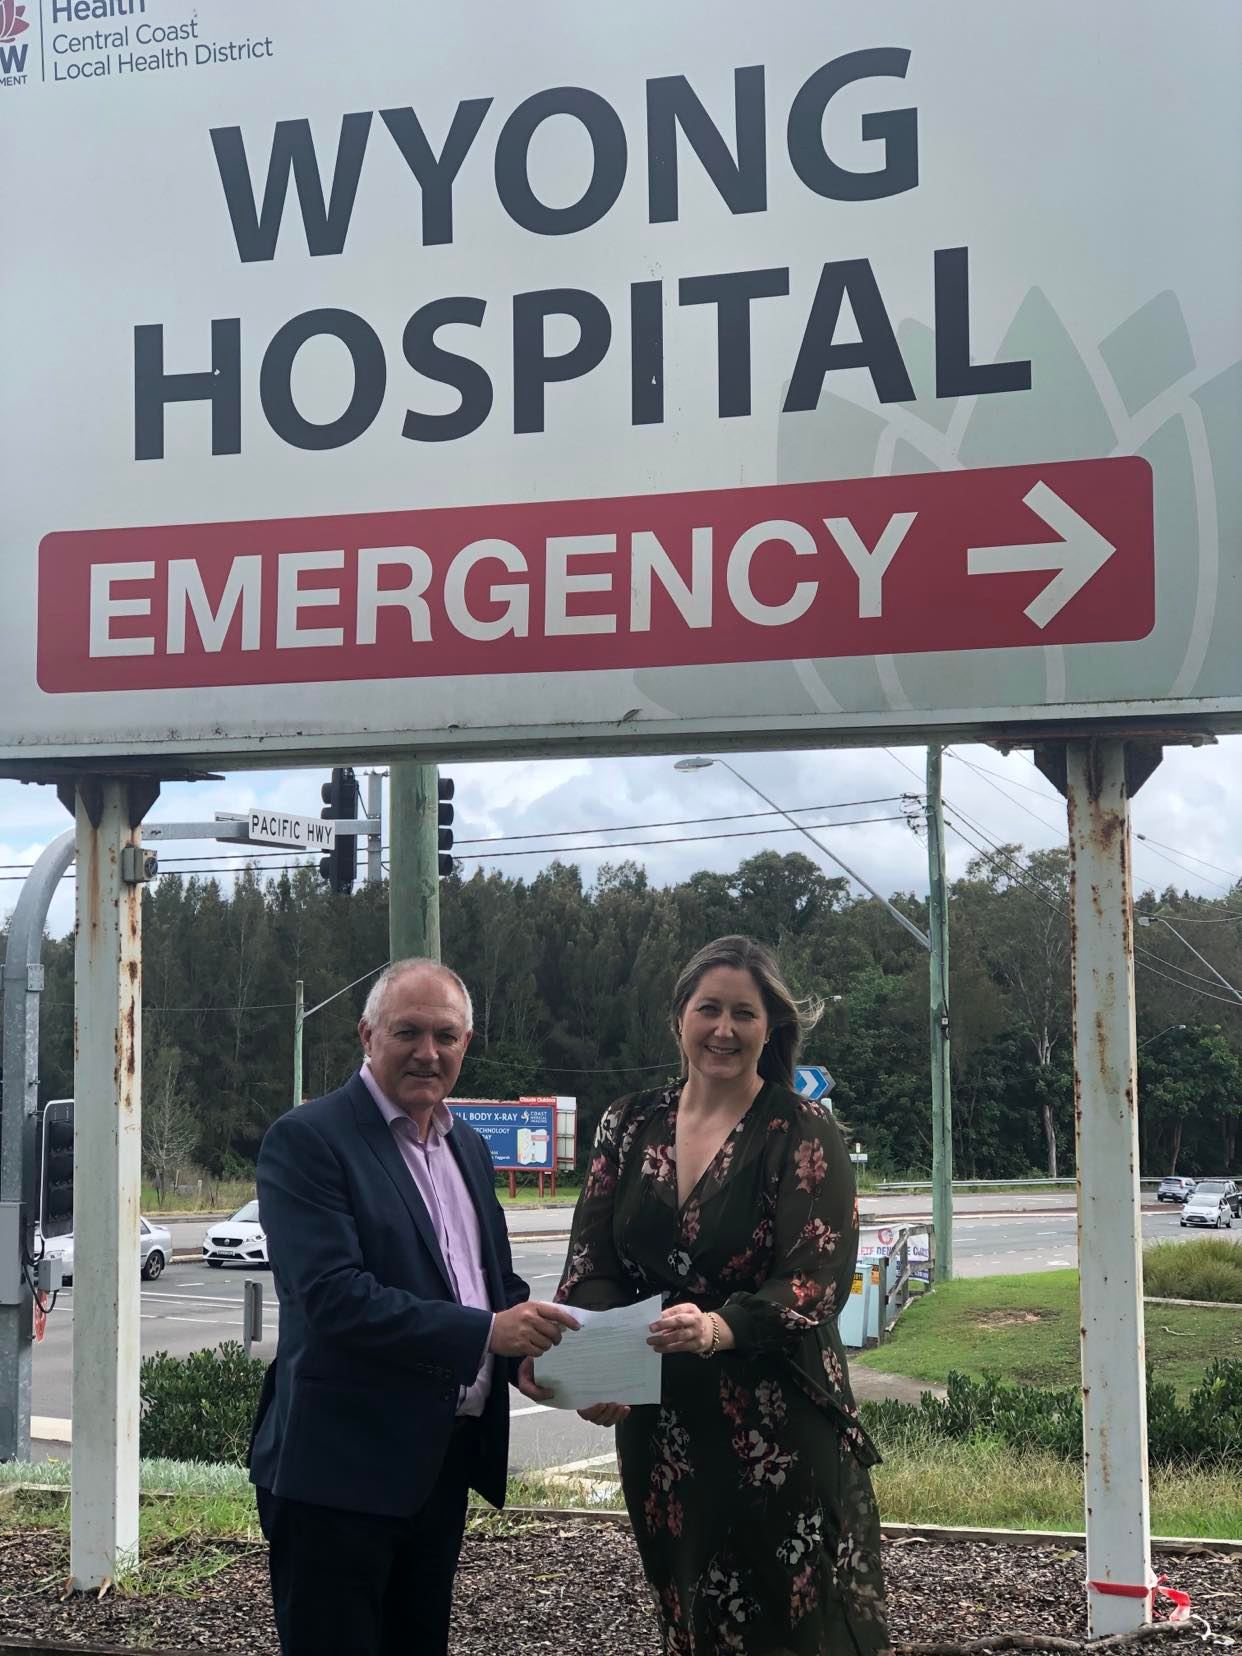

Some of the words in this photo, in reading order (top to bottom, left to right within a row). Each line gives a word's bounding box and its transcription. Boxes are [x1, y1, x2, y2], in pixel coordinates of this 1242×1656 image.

[53, 26, 129, 54] Central
[136, 18, 199, 44] Coast
[54, 54, 111, 81] Local
[118, 47, 188, 74] Health
[195, 37, 274, 65] District
[209, 47, 919, 263] WYONG
[134, 246, 1032, 460] HOSPITAL
[89, 511, 918, 658] EMERGENCY
[252, 815, 300, 839] PACIFIC
[307, 823, 333, 844] HWY
[470, 1112, 493, 1121] BODY
[494, 1112, 518, 1121] X-RAY
